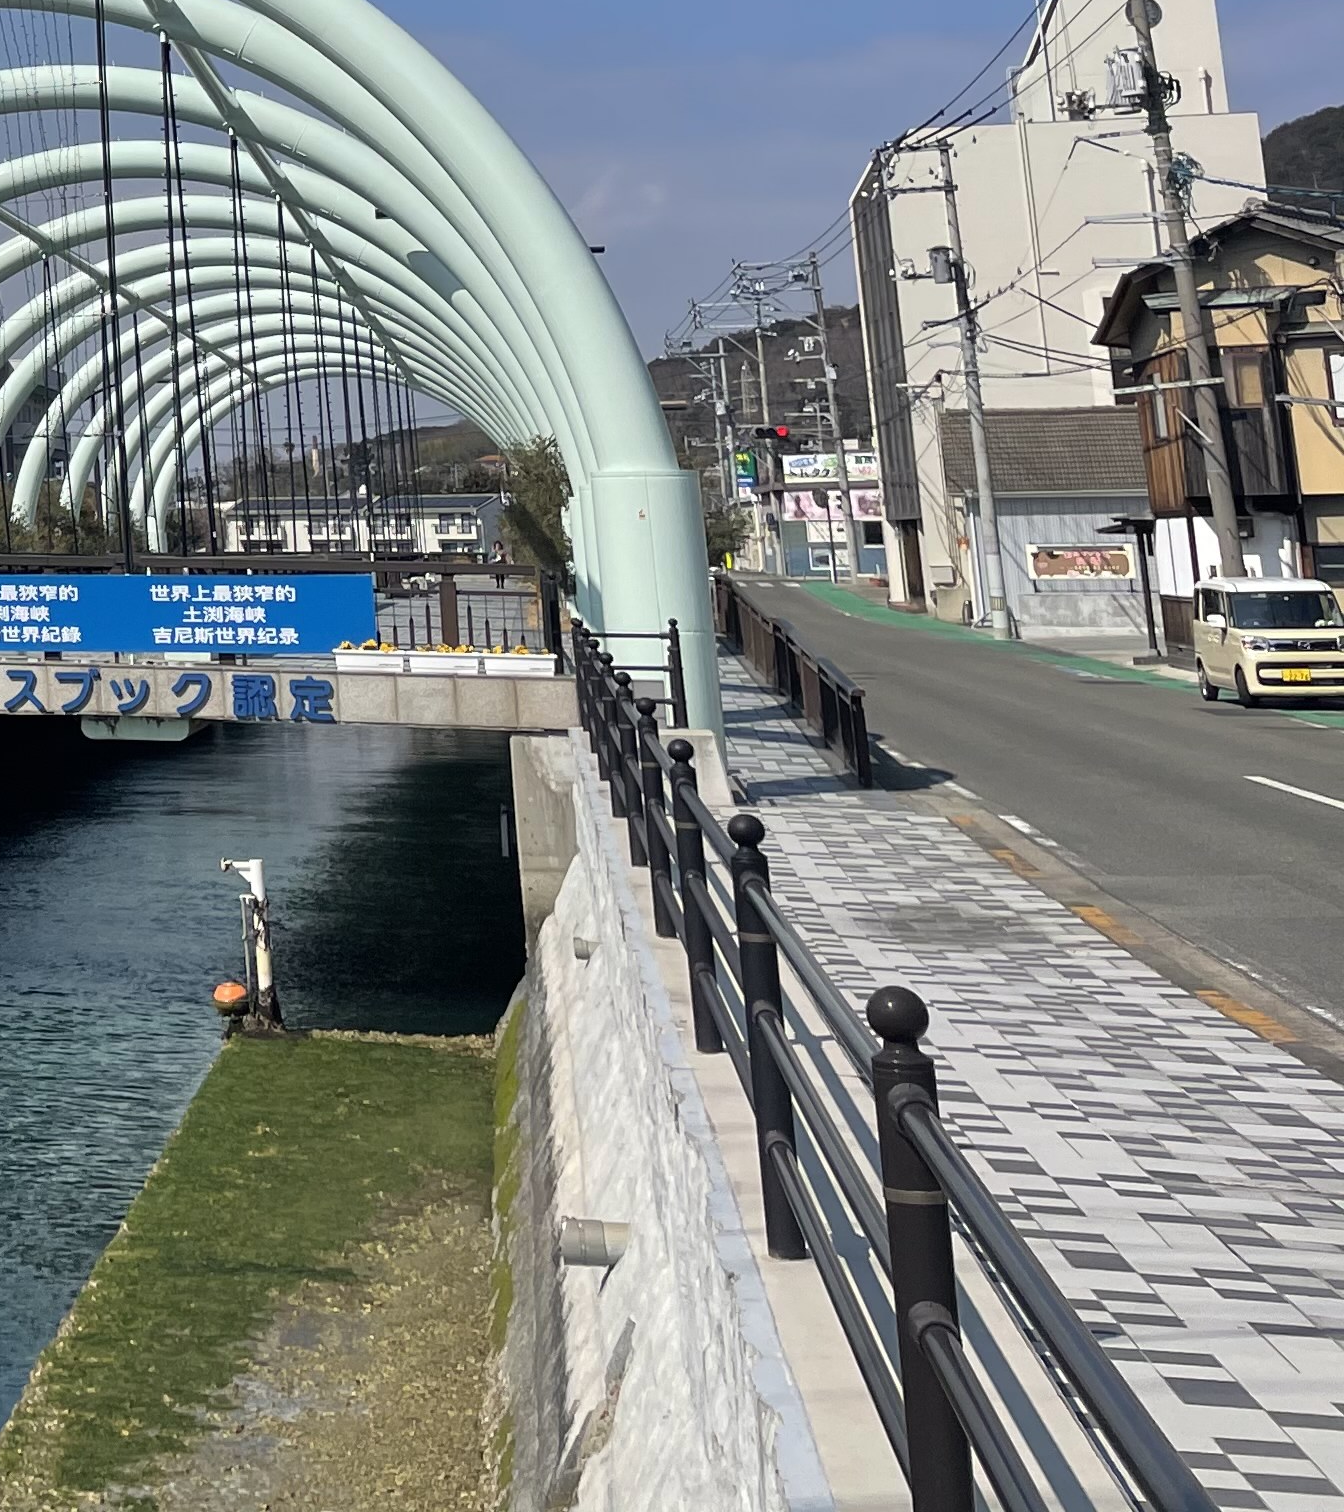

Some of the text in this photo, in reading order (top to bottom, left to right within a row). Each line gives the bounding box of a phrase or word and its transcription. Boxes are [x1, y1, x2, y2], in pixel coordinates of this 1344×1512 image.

[152, 625, 300, 645] 吉尼斯世界纪录
